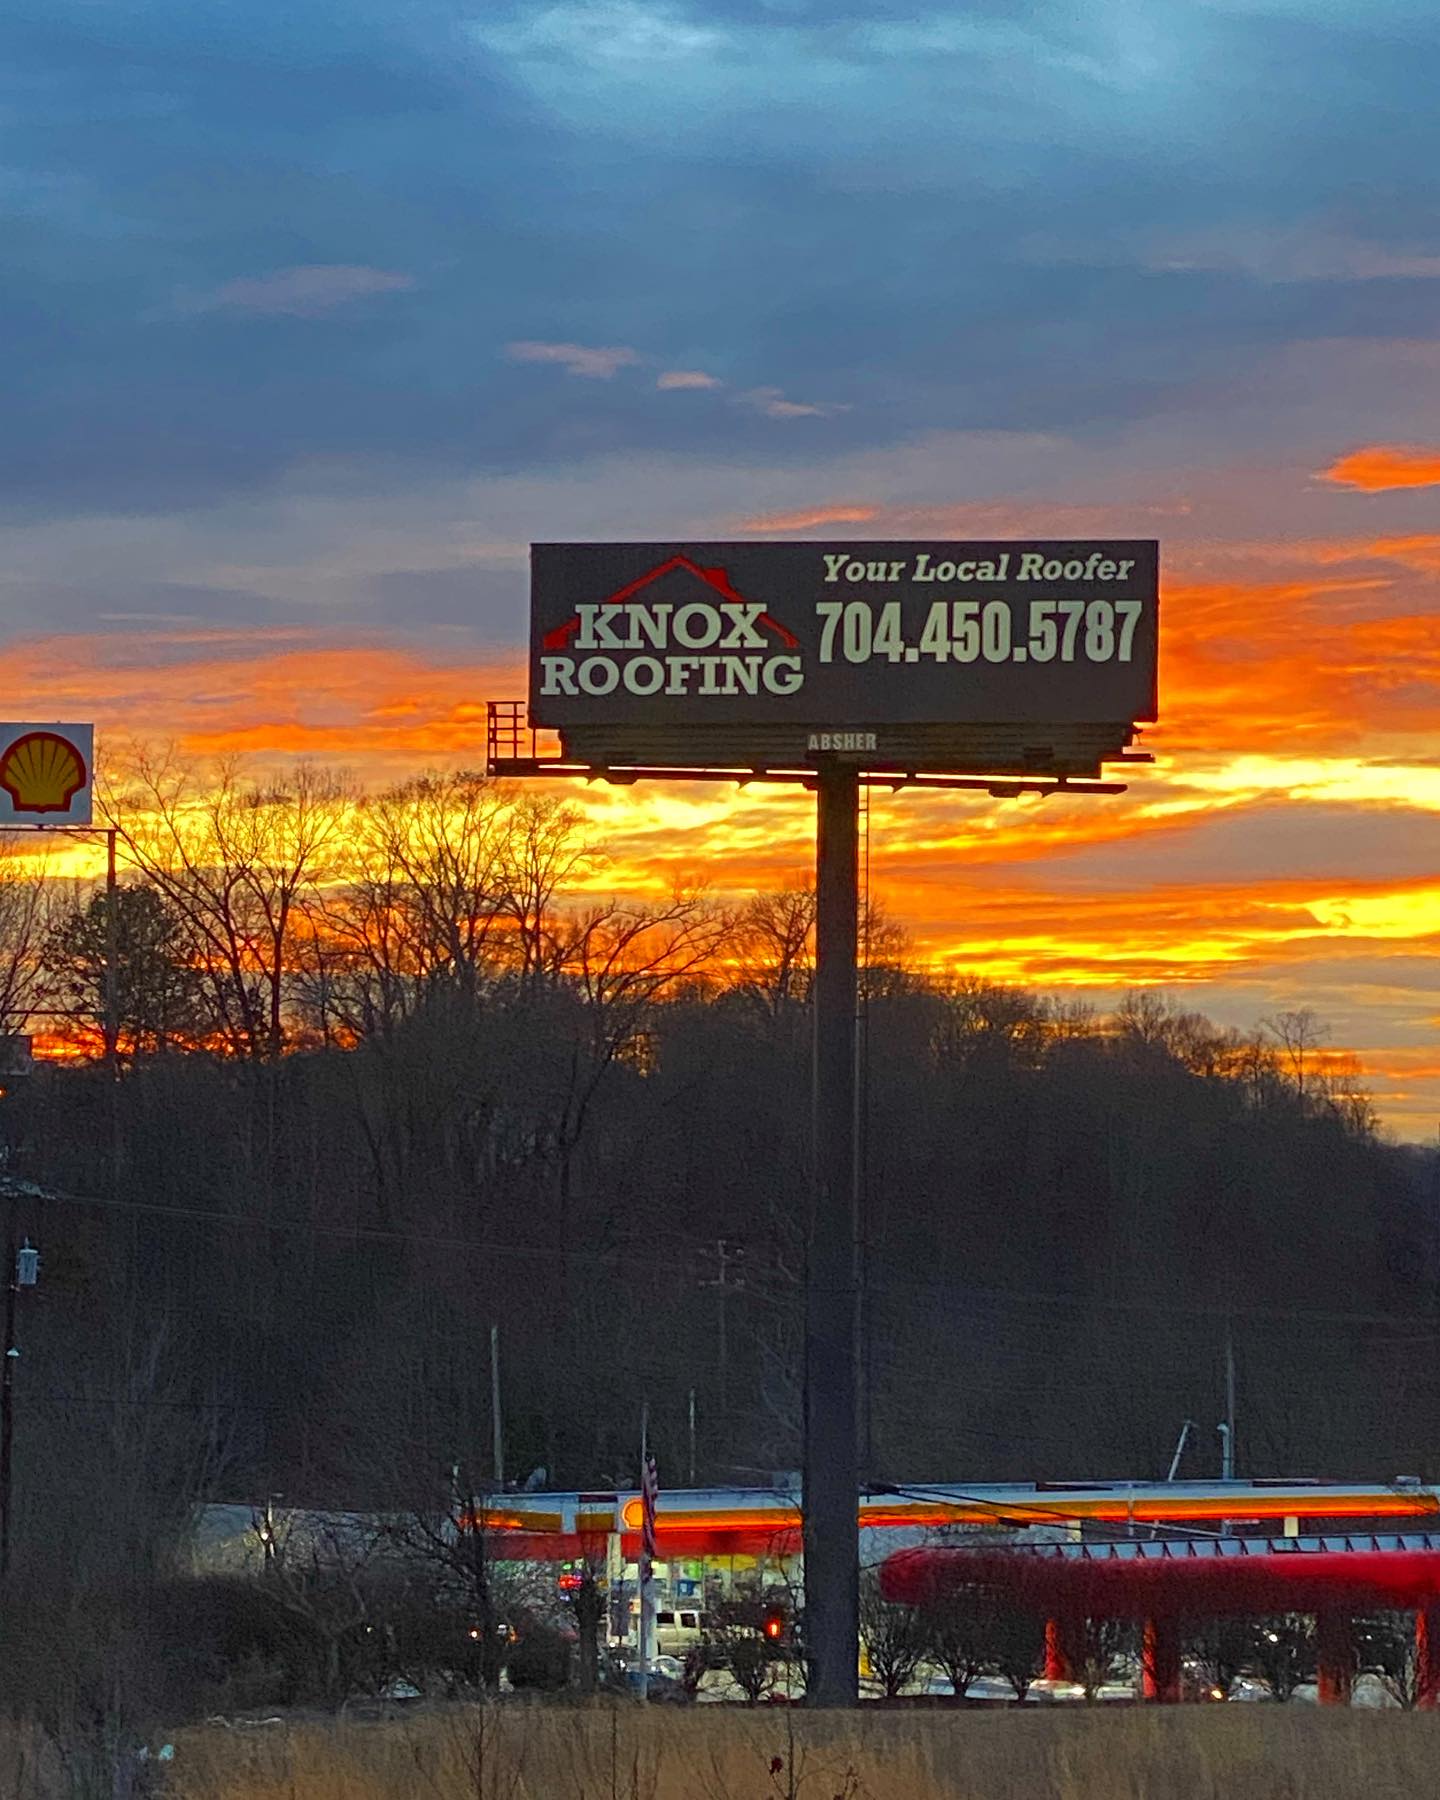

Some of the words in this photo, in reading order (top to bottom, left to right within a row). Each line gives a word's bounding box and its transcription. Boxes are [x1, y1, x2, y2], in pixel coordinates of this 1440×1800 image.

[823, 554, 905, 582] Your
[912, 554, 1009, 582] Local
[1016, 553, 1135, 581] Roofer
[574, 603, 768, 649] KNOX
[816, 600, 1143, 663] 704.450.5787
[540, 655, 804, 696] ROOFING
[807, 732, 877, 751] ABSHER
